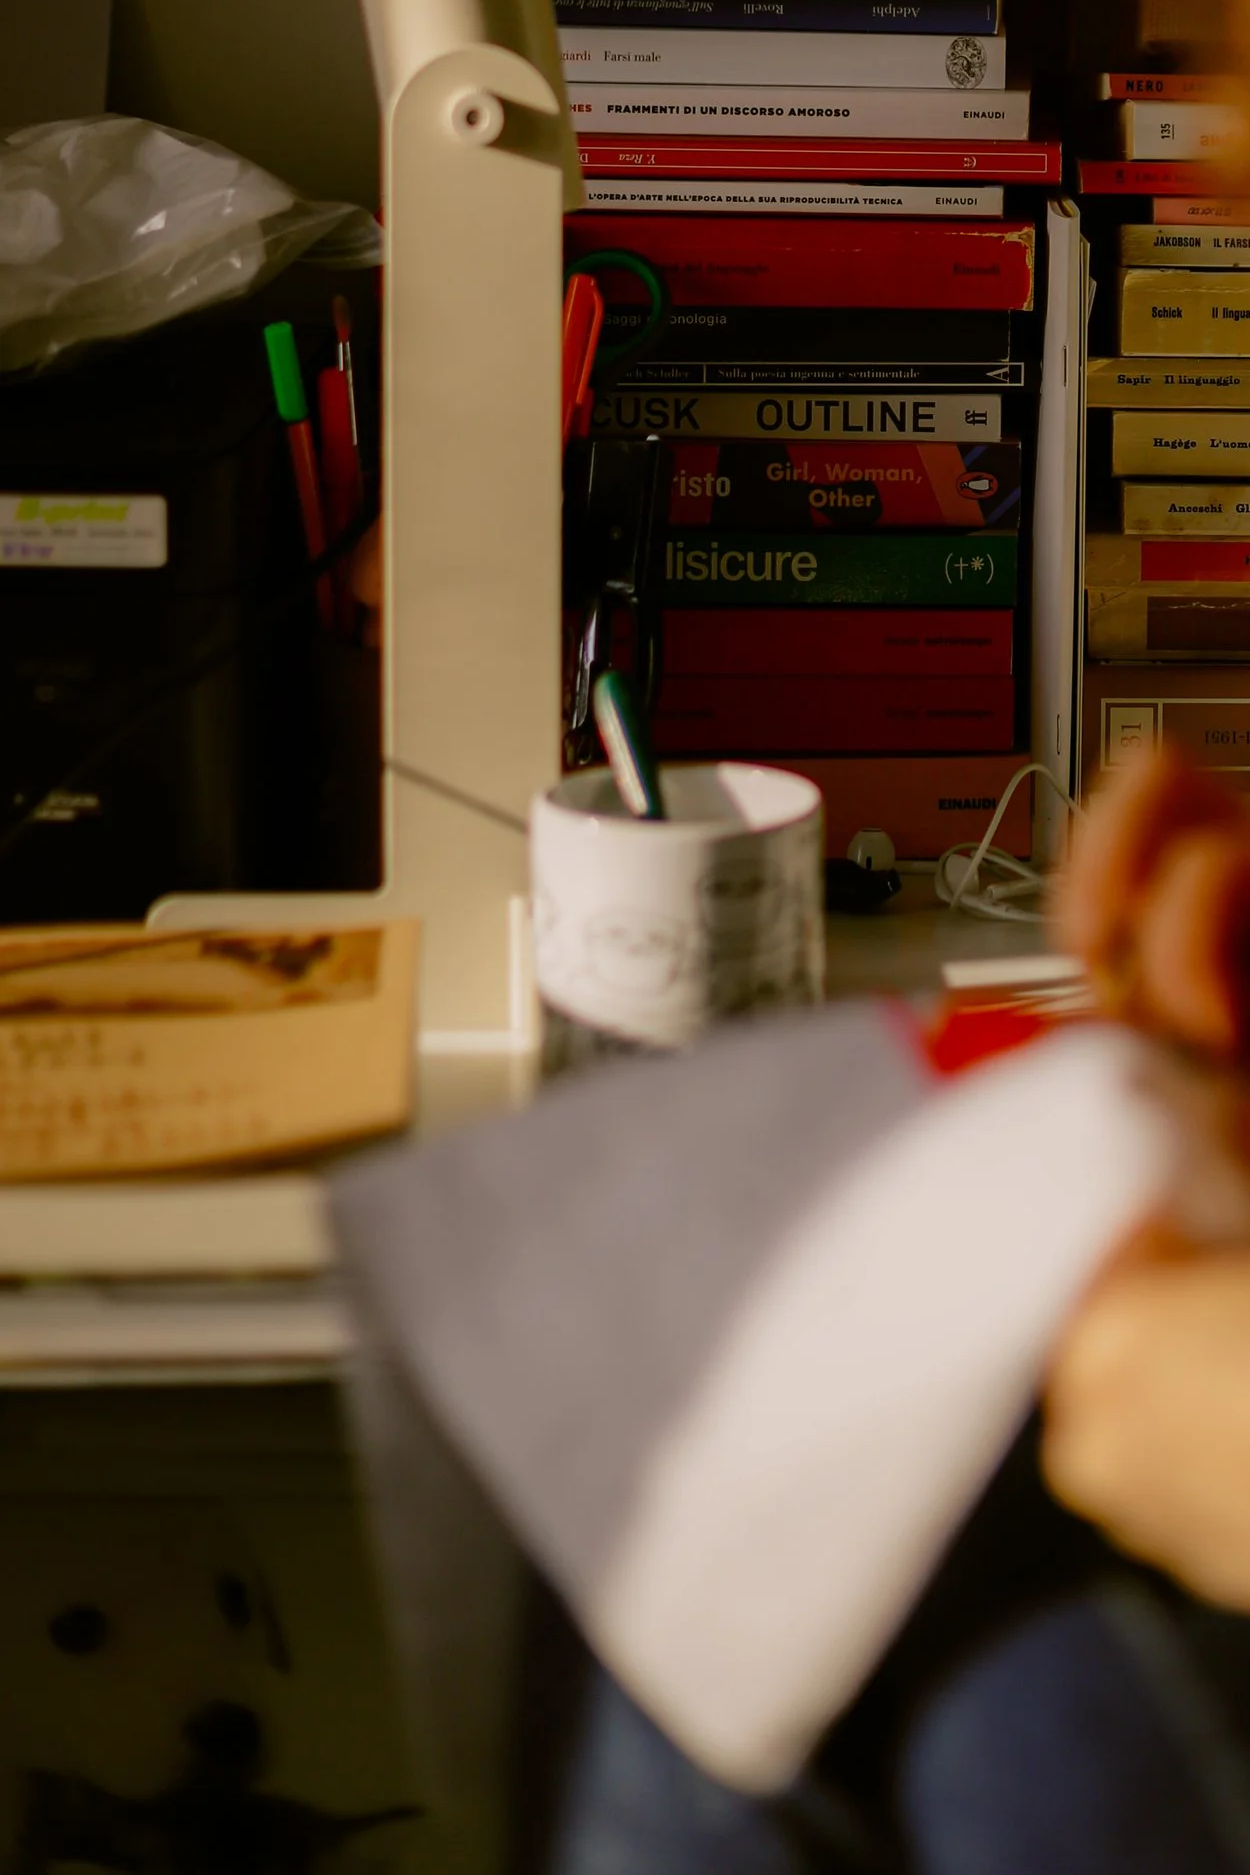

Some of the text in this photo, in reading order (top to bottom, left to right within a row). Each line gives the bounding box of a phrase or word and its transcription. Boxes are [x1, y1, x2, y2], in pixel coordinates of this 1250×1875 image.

[576, 0, 585, 10] le
[586, 0, 611, 9] tutte
[614, 0, 624, 11] di
[743, 3, 784, 15] Rovelli
[872, 3, 921, 18] Adelphi
[604, 50, 662, 62] Farsi male
[1126, 80, 1164, 93] NERO
[607, 104, 851, 118] FRAMMENTI DI UN DISCORSO AMOROSO
[963, 110, 1005, 120] EINAUDI
[1160, 122, 1172, 140] 135
[618, 153, 643, 164] Reza
[588, 192, 903, 206] L'OPERA D'ARTE NELL'EPOCA DELLA SUA RIPRODUCIBILITÀ TECNICA
[935, 197, 978, 206] EINAUDI
[1153, 236, 1202, 249] JAKOBSON
[1213, 237, 1223, 248] IL
[1225, 238, 1250, 249] FARSI
[1151, 306, 1183, 319] Schick
[1211, 306, 1220, 319] Il
[603, 312, 728, 327] Saggi onologia
[717, 368, 921, 382] Sulla poesia ingenua e sentimentale
[1117, 373, 1152, 386] Sapir
[1164, 373, 1241, 387] Il linguaggio
[756, 399, 937, 433] OUTLINE
[1152, 437, 1197, 450] Hagège
[766, 461, 924, 486] Girl, Woman,
[673, 469, 731, 499] isto
[808, 487, 876, 508] Other
[1168, 503, 1223, 515] Anceschi
[938, 797, 997, 811] EINAUDI
